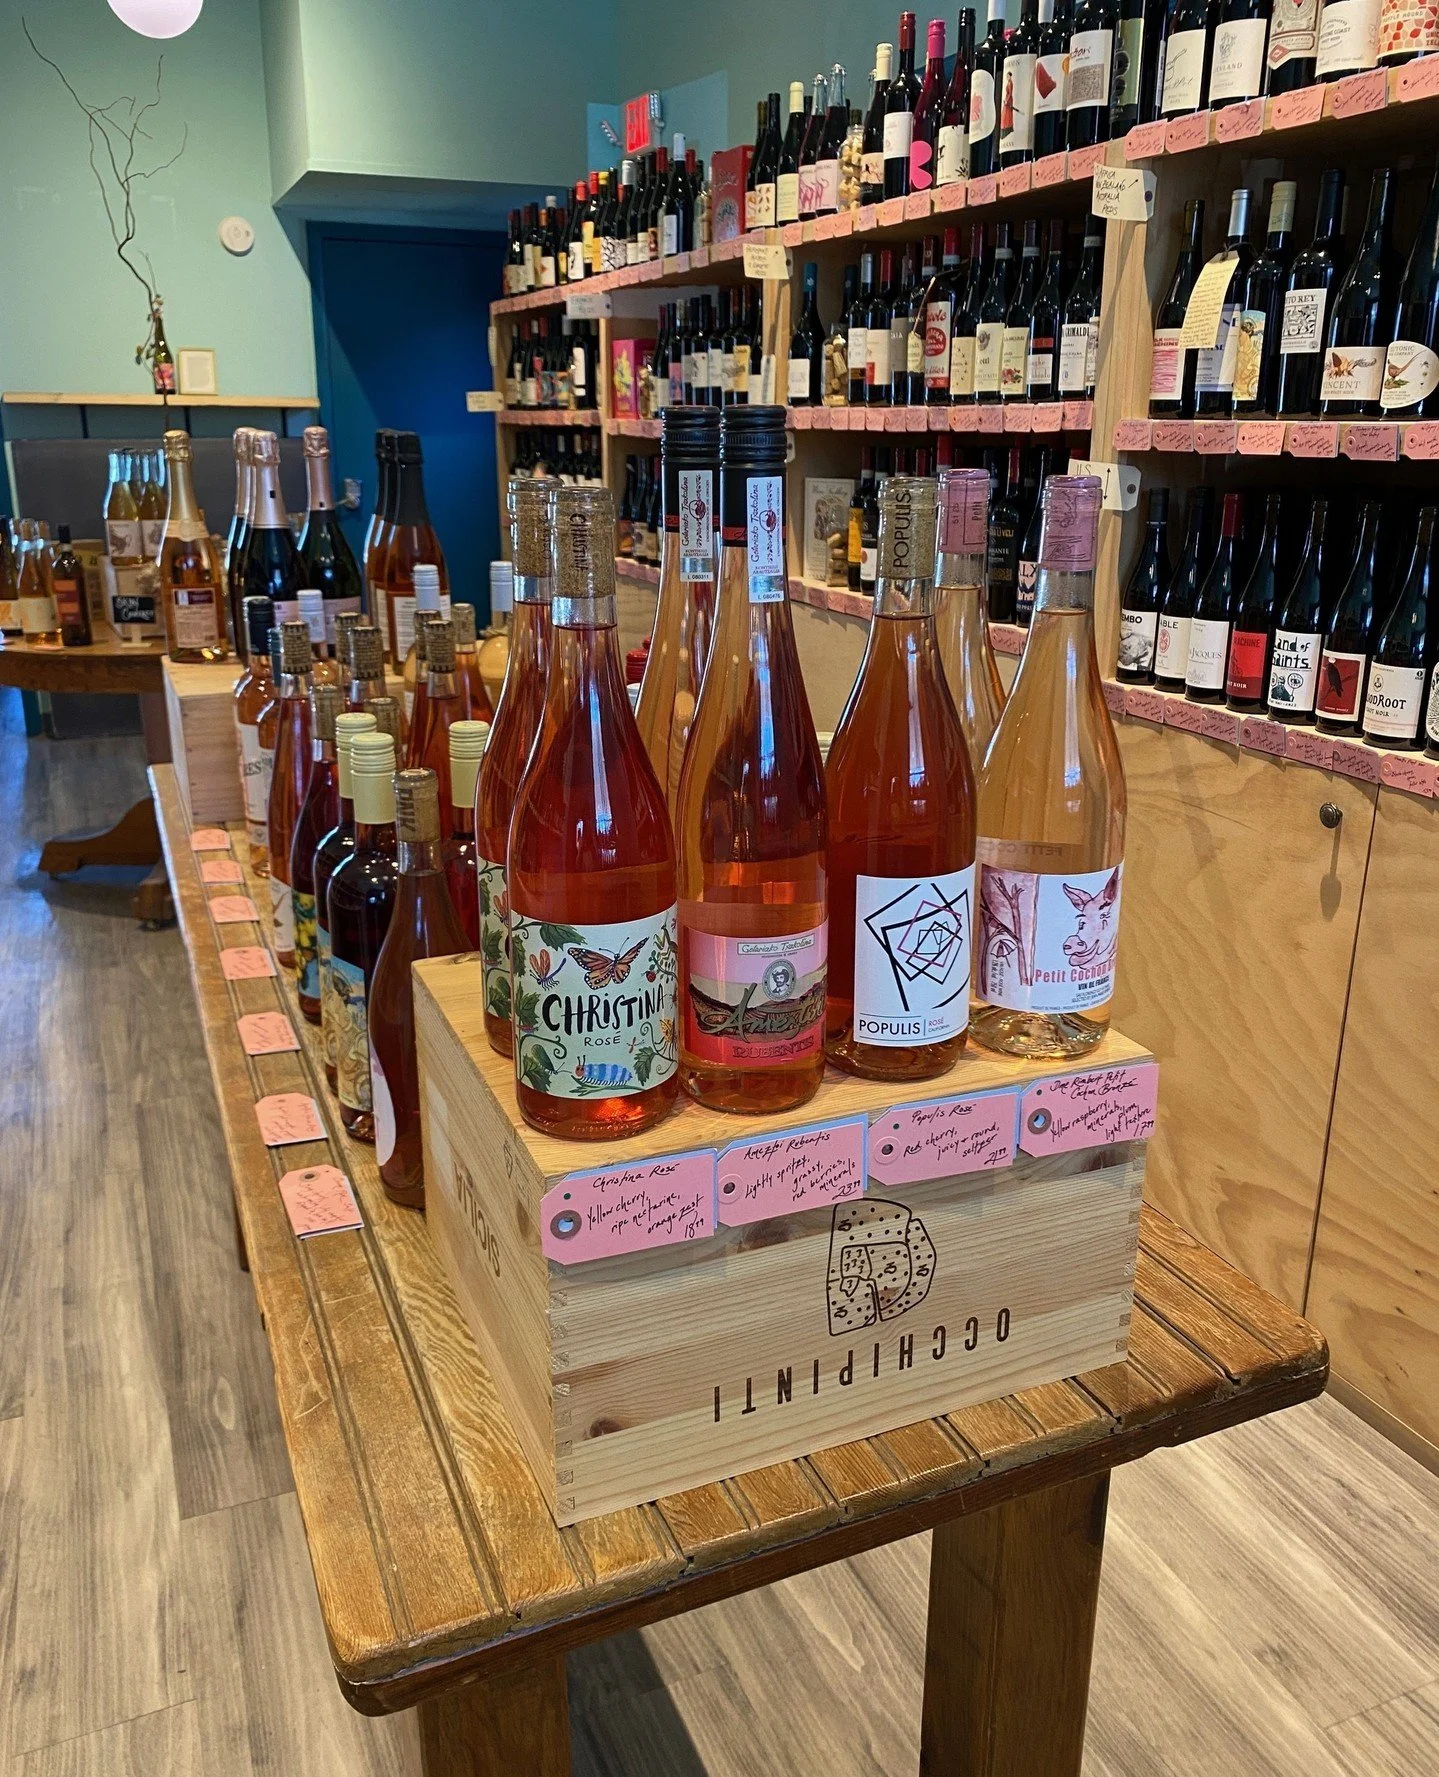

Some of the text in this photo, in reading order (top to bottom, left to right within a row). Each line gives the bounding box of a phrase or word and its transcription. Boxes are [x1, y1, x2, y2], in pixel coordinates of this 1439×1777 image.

[1298, 294, 1316, 303] REY
[893, 491, 912, 568] POPULIS
[1035, 969, 1066, 983] Petit
[1070, 964, 1107, 983] Cochon
[542, 983, 665, 1036] CHRISTINA
[859, 1019, 921, 1035] POPULIS
[584, 1031, 621, 1047] ROSÉ
[912, 1106, 945, 1126] Populis
[592, 1171, 644, 1193] Christina
[454, 1161, 500, 1278] SICILIA
[611, 1218, 629, 1235] ripe
[647, 1213, 678, 1235] orange
[714, 1308, 1010, 1422] OCCHIPINTI
